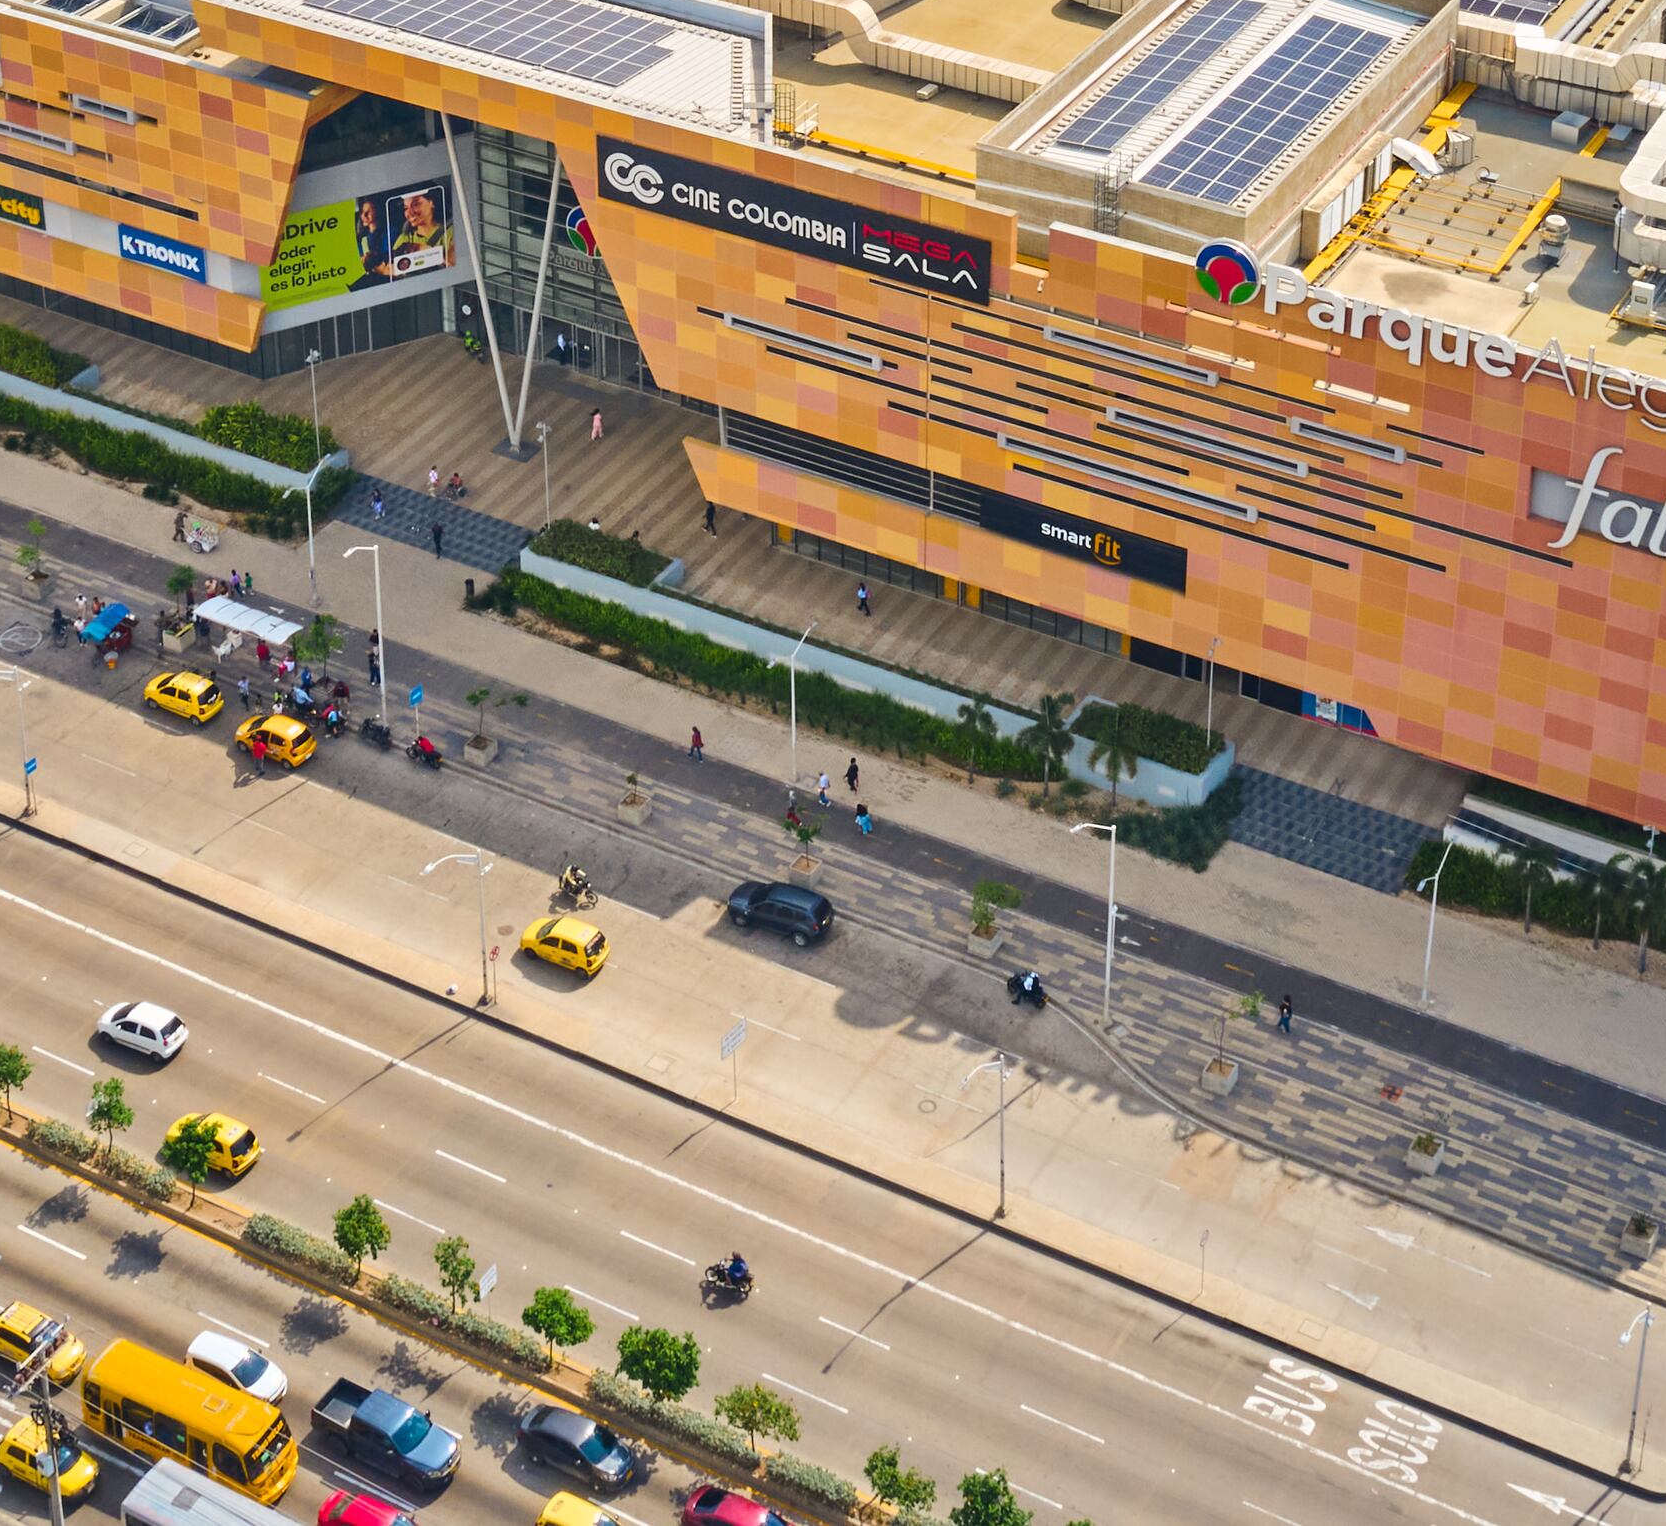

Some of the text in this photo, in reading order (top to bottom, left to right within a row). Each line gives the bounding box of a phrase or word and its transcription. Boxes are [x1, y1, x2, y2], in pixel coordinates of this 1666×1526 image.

[671, 182, 720, 214] CINE
[727, 198, 847, 249] COLOMBIA
[862, 224, 978, 270] MEGA
[269, 258, 316, 278] elegir,
[277, 243, 316, 262] oder
[862, 242, 978, 291] SALA
[270, 264, 347, 293] es lo justo
[1263, 262, 1516, 378] Parque
[1041, 522, 1121, 562] smart fit
[1242, 1358, 1339, 1437] BUS
[1347, 1399, 1444, 1484] SOLO
